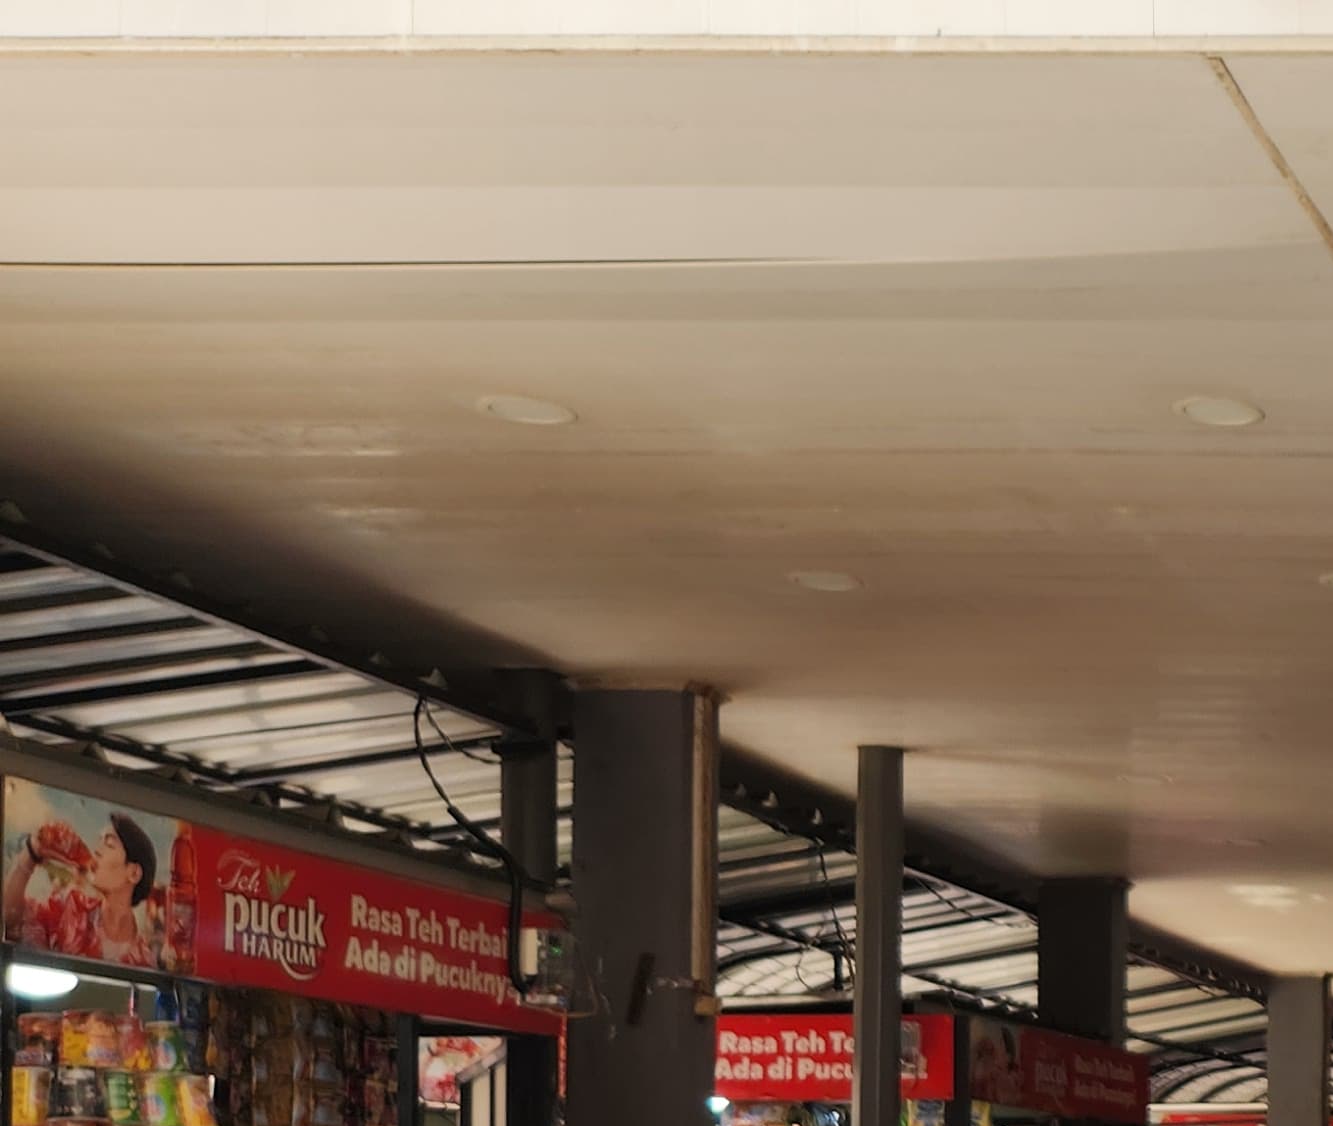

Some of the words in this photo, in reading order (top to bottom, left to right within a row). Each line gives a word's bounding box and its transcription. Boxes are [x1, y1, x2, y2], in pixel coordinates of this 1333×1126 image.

[351, 894, 402, 937] Rasa
[406, 906, 445, 945] Teh
[446, 914, 508, 960] Terbai
[242, 935, 319, 969] HARUM
[345, 935, 390, 976] Ada
[393, 943, 417, 983] di
[719, 1030, 778, 1055] Rasa
[781, 1029, 826, 1055] Teh
[714, 1057, 764, 1081] Ada
[766, 1056, 794, 1081] di
